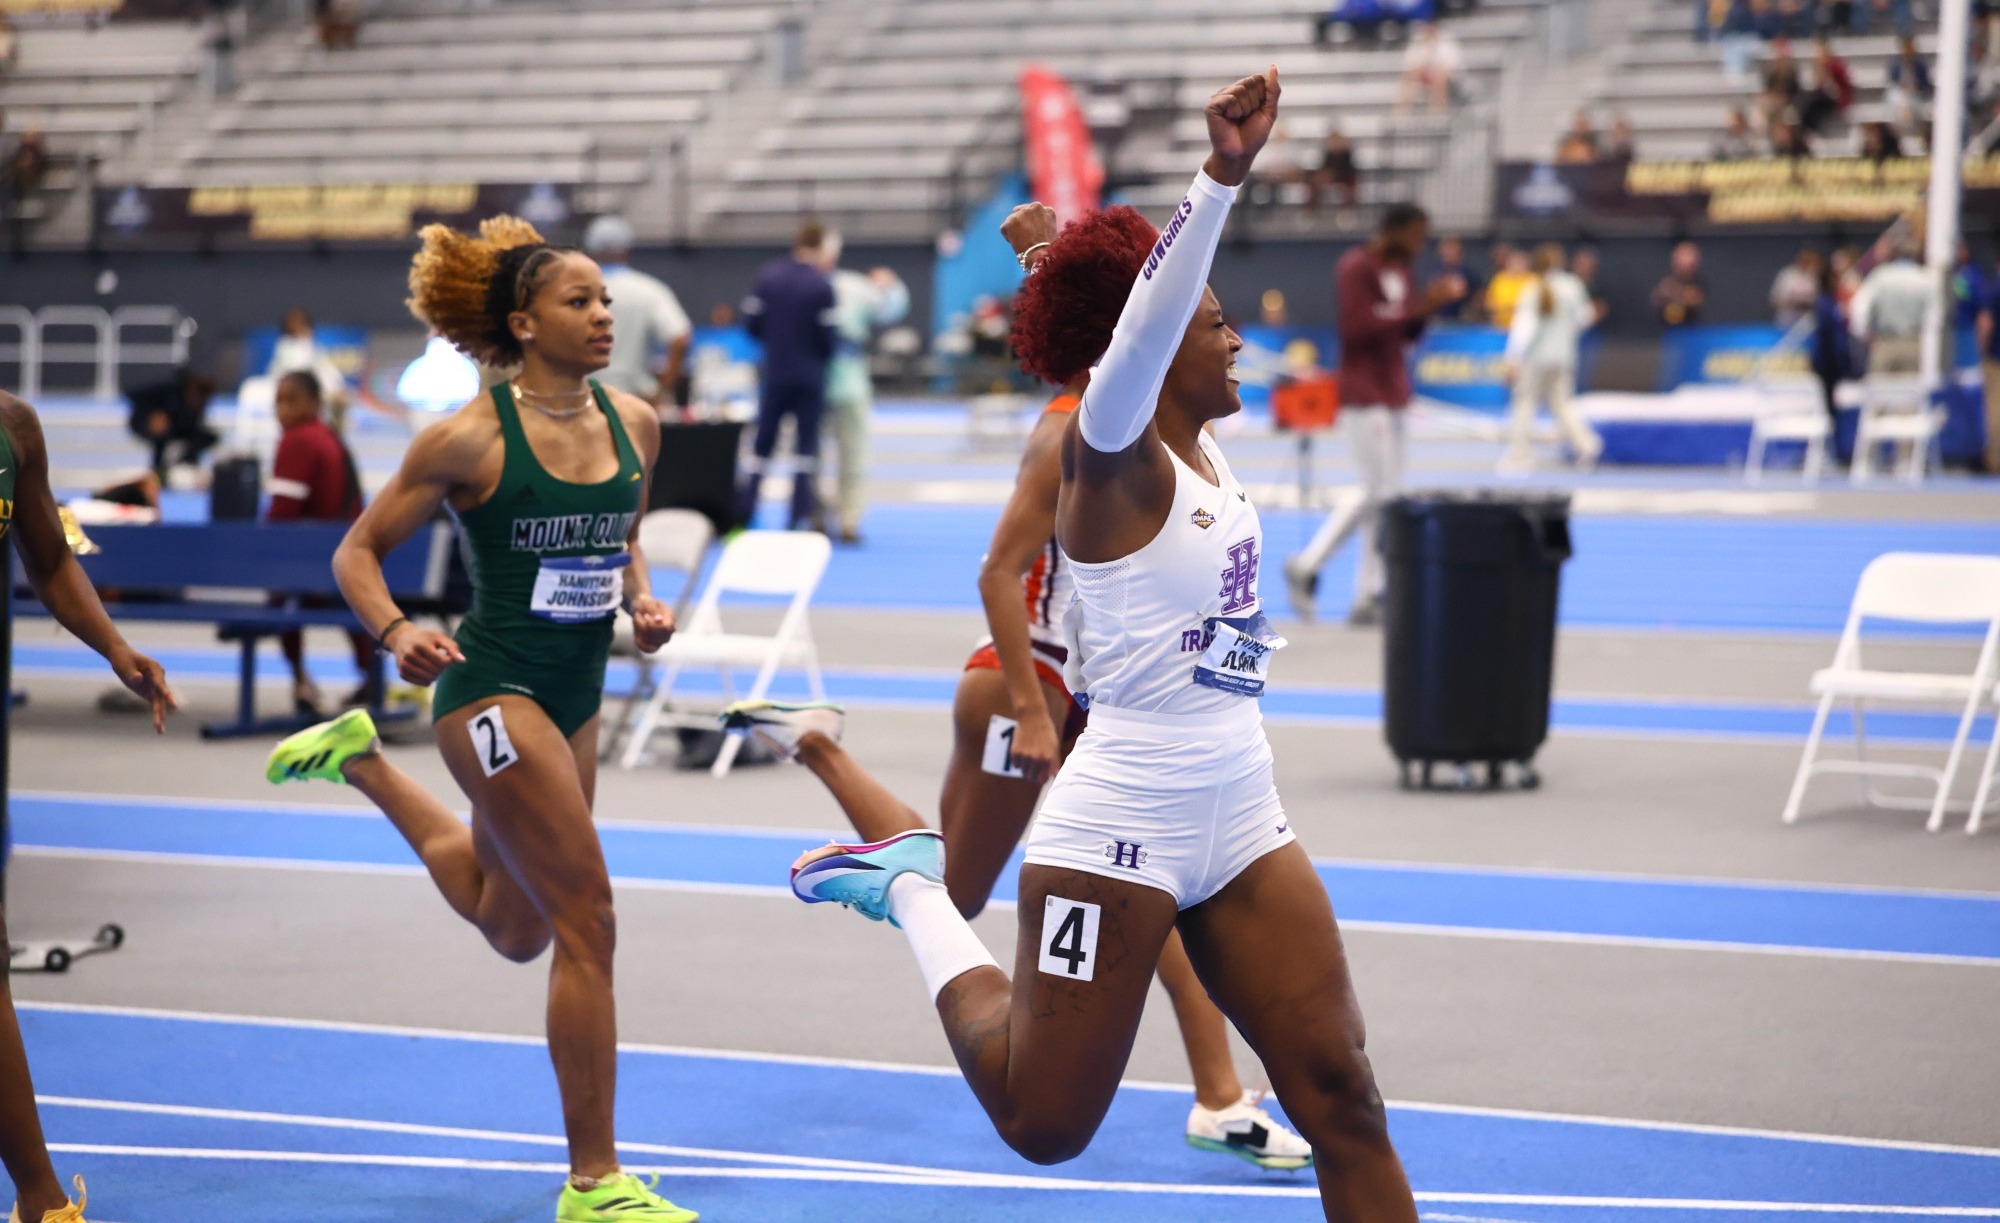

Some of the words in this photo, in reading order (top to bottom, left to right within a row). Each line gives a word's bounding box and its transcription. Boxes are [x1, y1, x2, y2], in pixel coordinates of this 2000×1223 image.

[1143, 196, 1192, 280] COWGIRLS
[511, 514, 593, 552] MOUNT
[1181, 629, 1214, 652] TRA
[477, 716, 510, 770] 2
[1001, 726, 1016, 772] 1
[1111, 840, 1142, 870] H
[1049, 906, 1087, 975] 4
